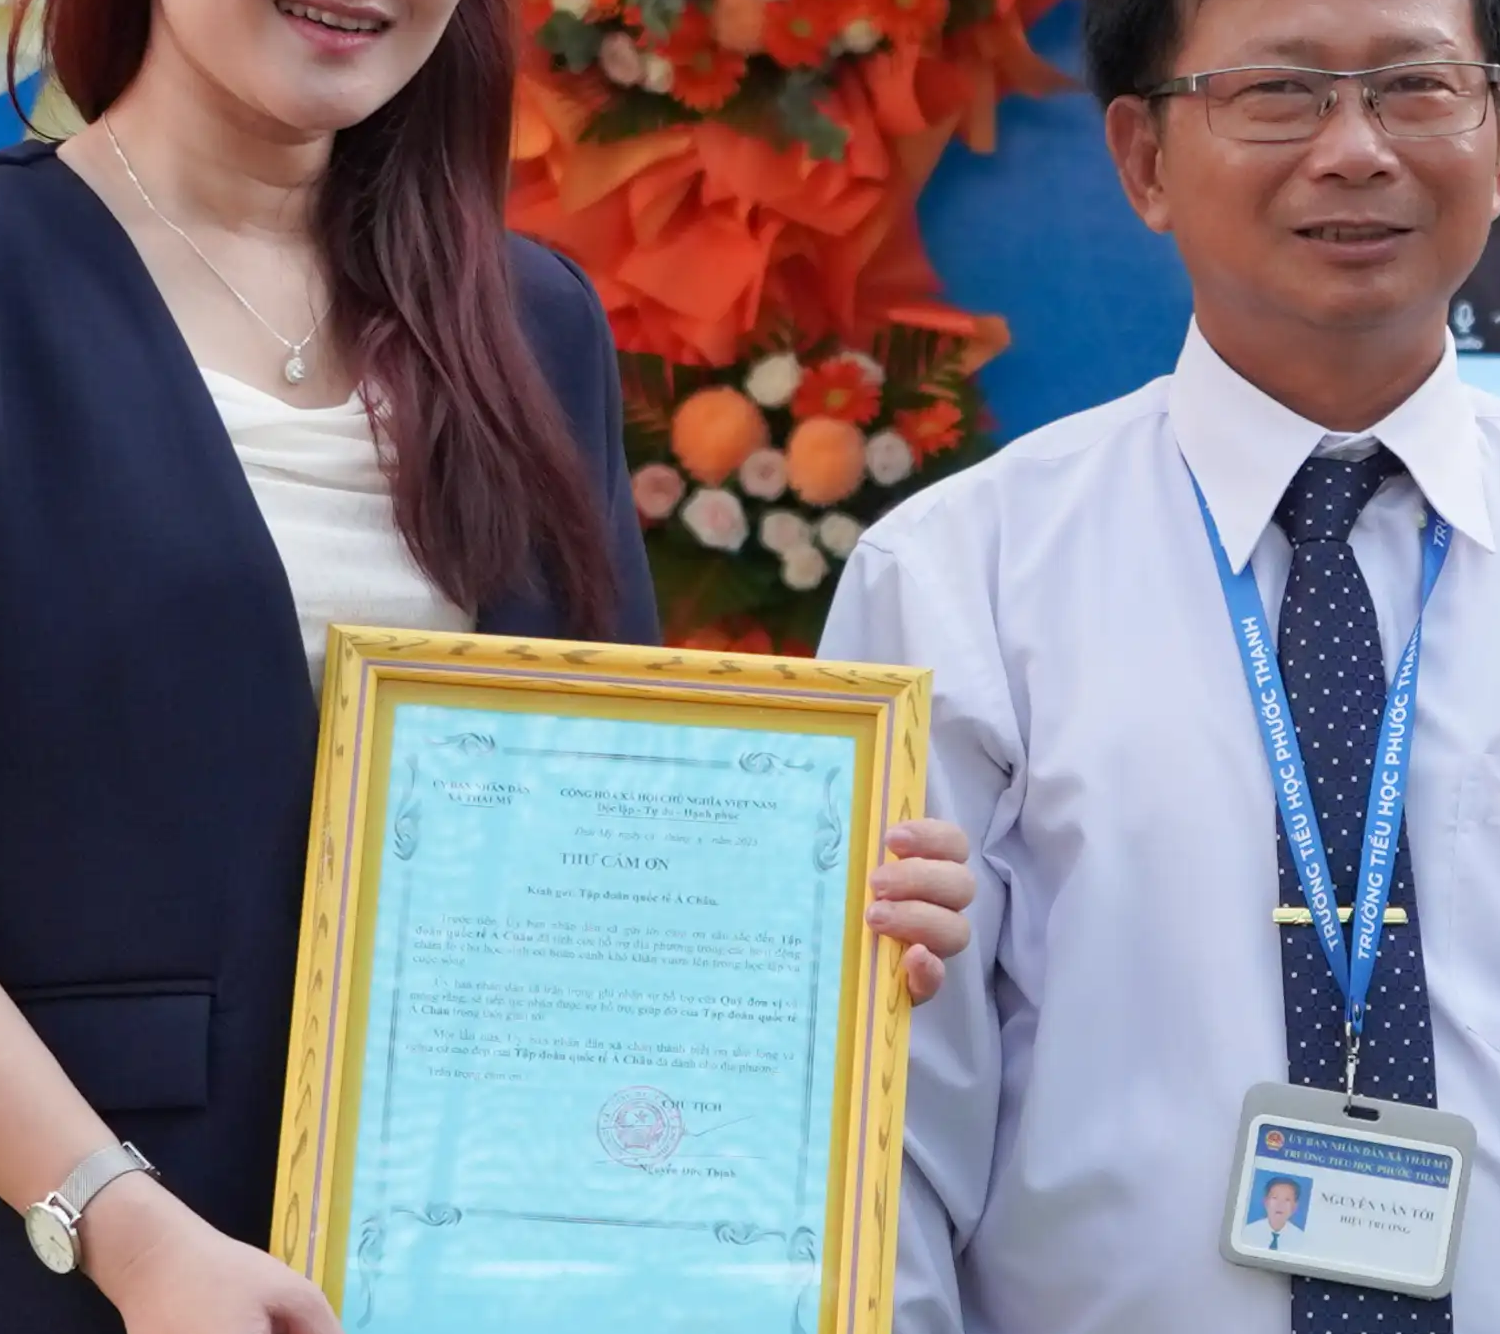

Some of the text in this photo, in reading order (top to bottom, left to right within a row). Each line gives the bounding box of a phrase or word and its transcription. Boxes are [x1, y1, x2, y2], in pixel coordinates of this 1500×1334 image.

[1385, 693, 1408, 766] PHƯỚC
[1241, 616, 1340, 952] TRƯỜNG TIỂU HỌC PHƯỚC THẠNH
[1378, 772, 1400, 816] HỌC
[559, 848, 671, 872] THƯ CẢM ƠN
[1369, 822, 1391, 867] TIỂU
[1358, 874, 1385, 959] TRƯỜNG
